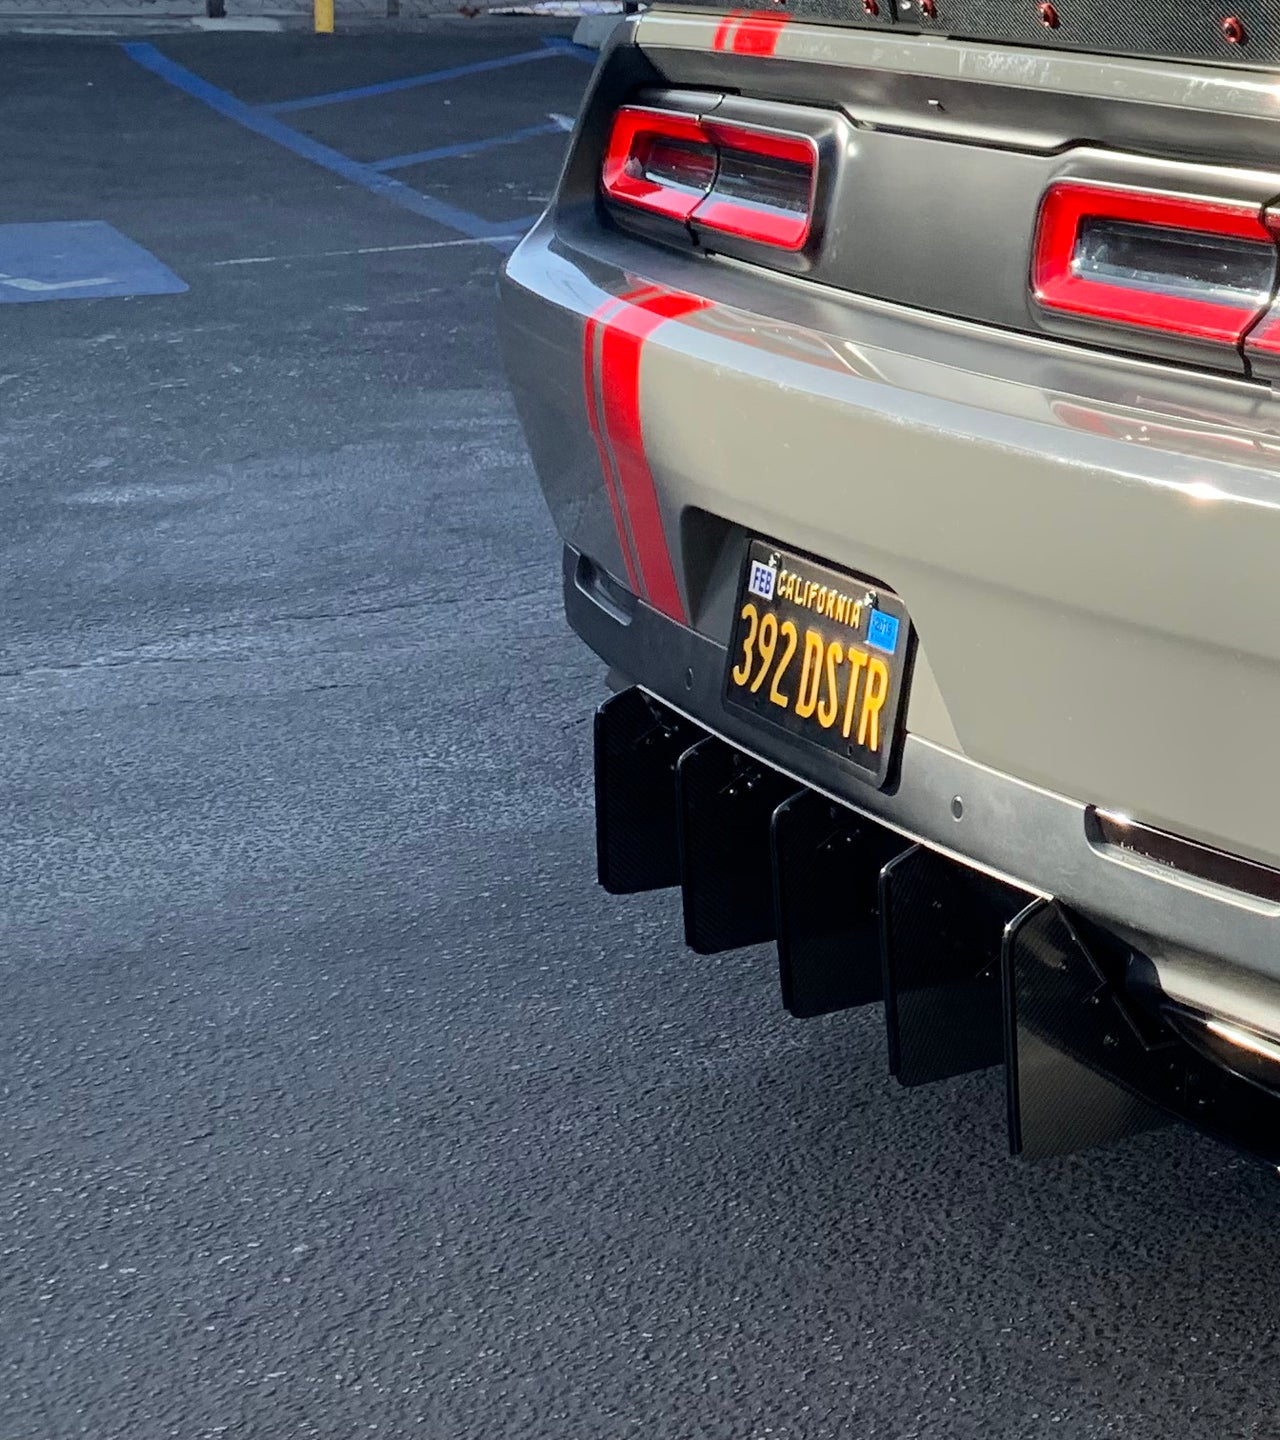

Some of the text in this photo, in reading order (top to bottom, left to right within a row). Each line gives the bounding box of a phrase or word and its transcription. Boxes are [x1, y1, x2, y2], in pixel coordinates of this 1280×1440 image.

[752, 566, 772, 595] FEB
[776, 568, 864, 630] CALIFORNIA
[731, 603, 890, 753] 392 DSTR
